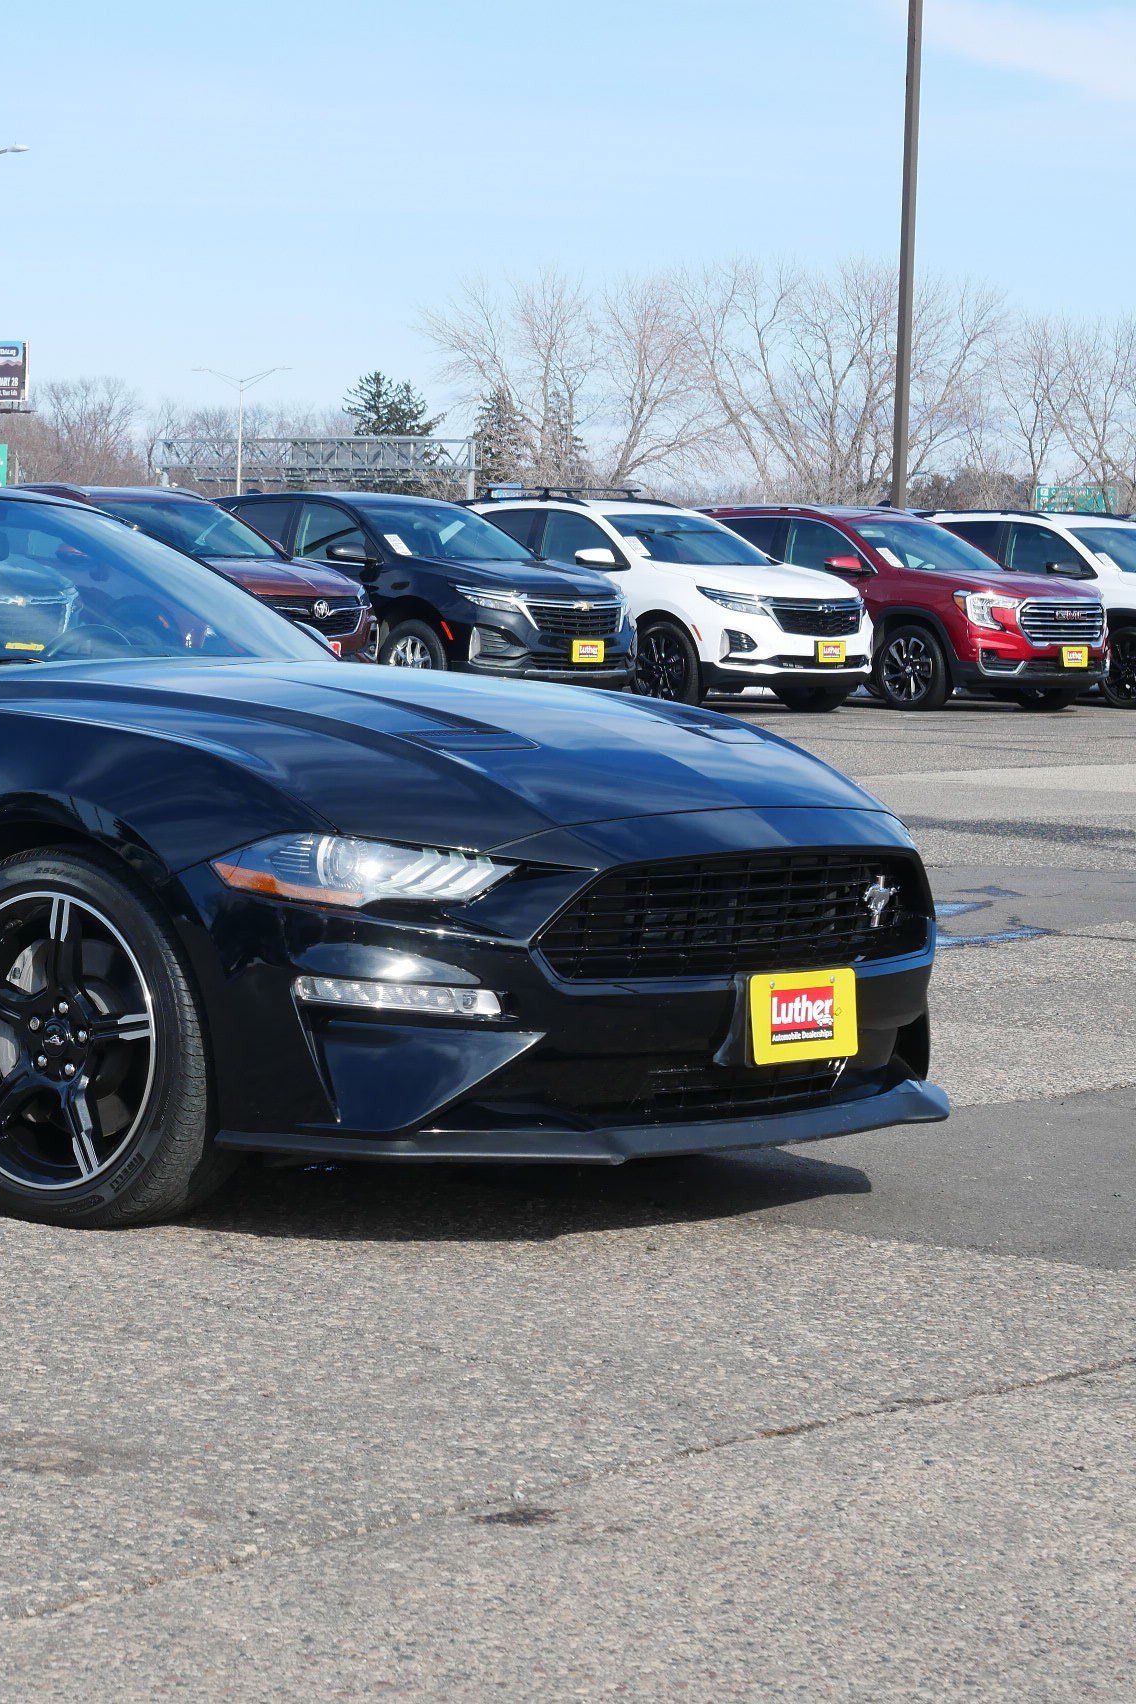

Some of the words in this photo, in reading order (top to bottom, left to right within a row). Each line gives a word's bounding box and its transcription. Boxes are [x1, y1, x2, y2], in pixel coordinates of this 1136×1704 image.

[11, 377, 19, 386] 28
[1055, 610, 1087, 620] GMC
[772, 994, 833, 1025] Luther
[772, 1032, 801, 1042] Automobile
[802, 1030, 833, 1039] Dealerships
